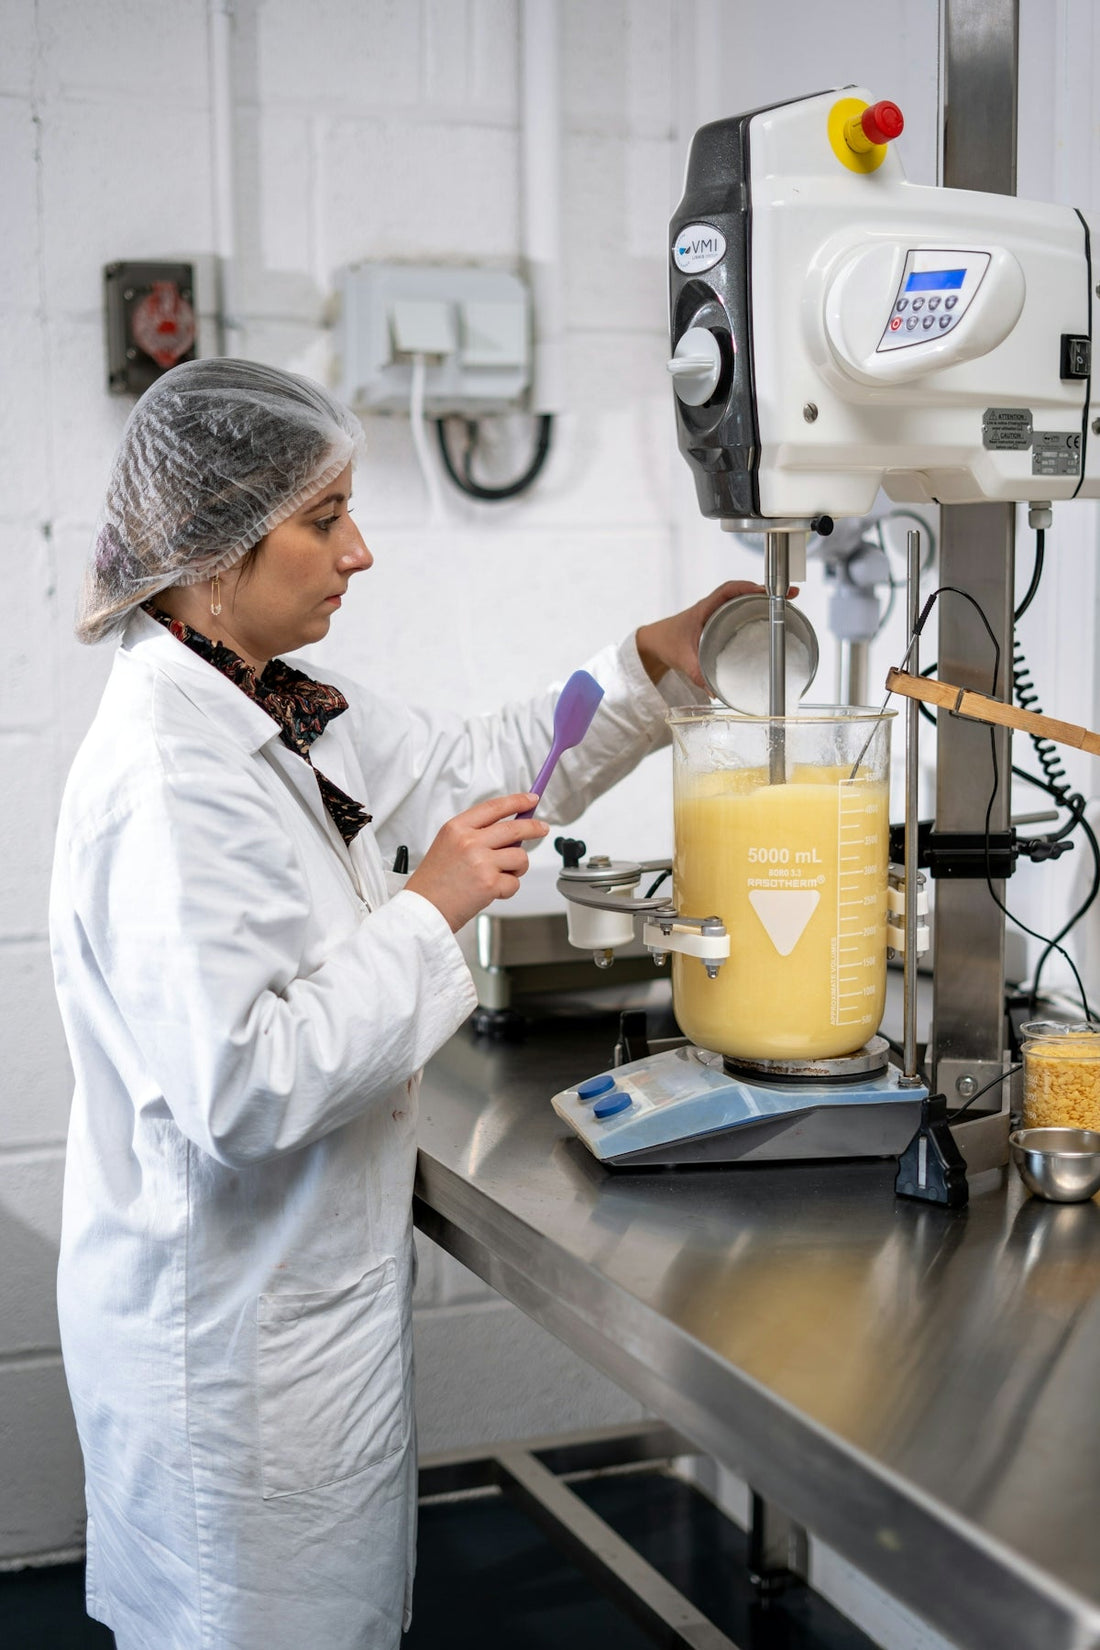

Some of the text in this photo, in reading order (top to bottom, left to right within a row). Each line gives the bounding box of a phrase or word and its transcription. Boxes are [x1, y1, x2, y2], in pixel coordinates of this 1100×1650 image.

[692, 238, 717, 253] VMI
[1066, 435, 1080, 449] CE
[748, 847, 822, 863] 5000 mL
[790, 869, 802, 877] 3.3
